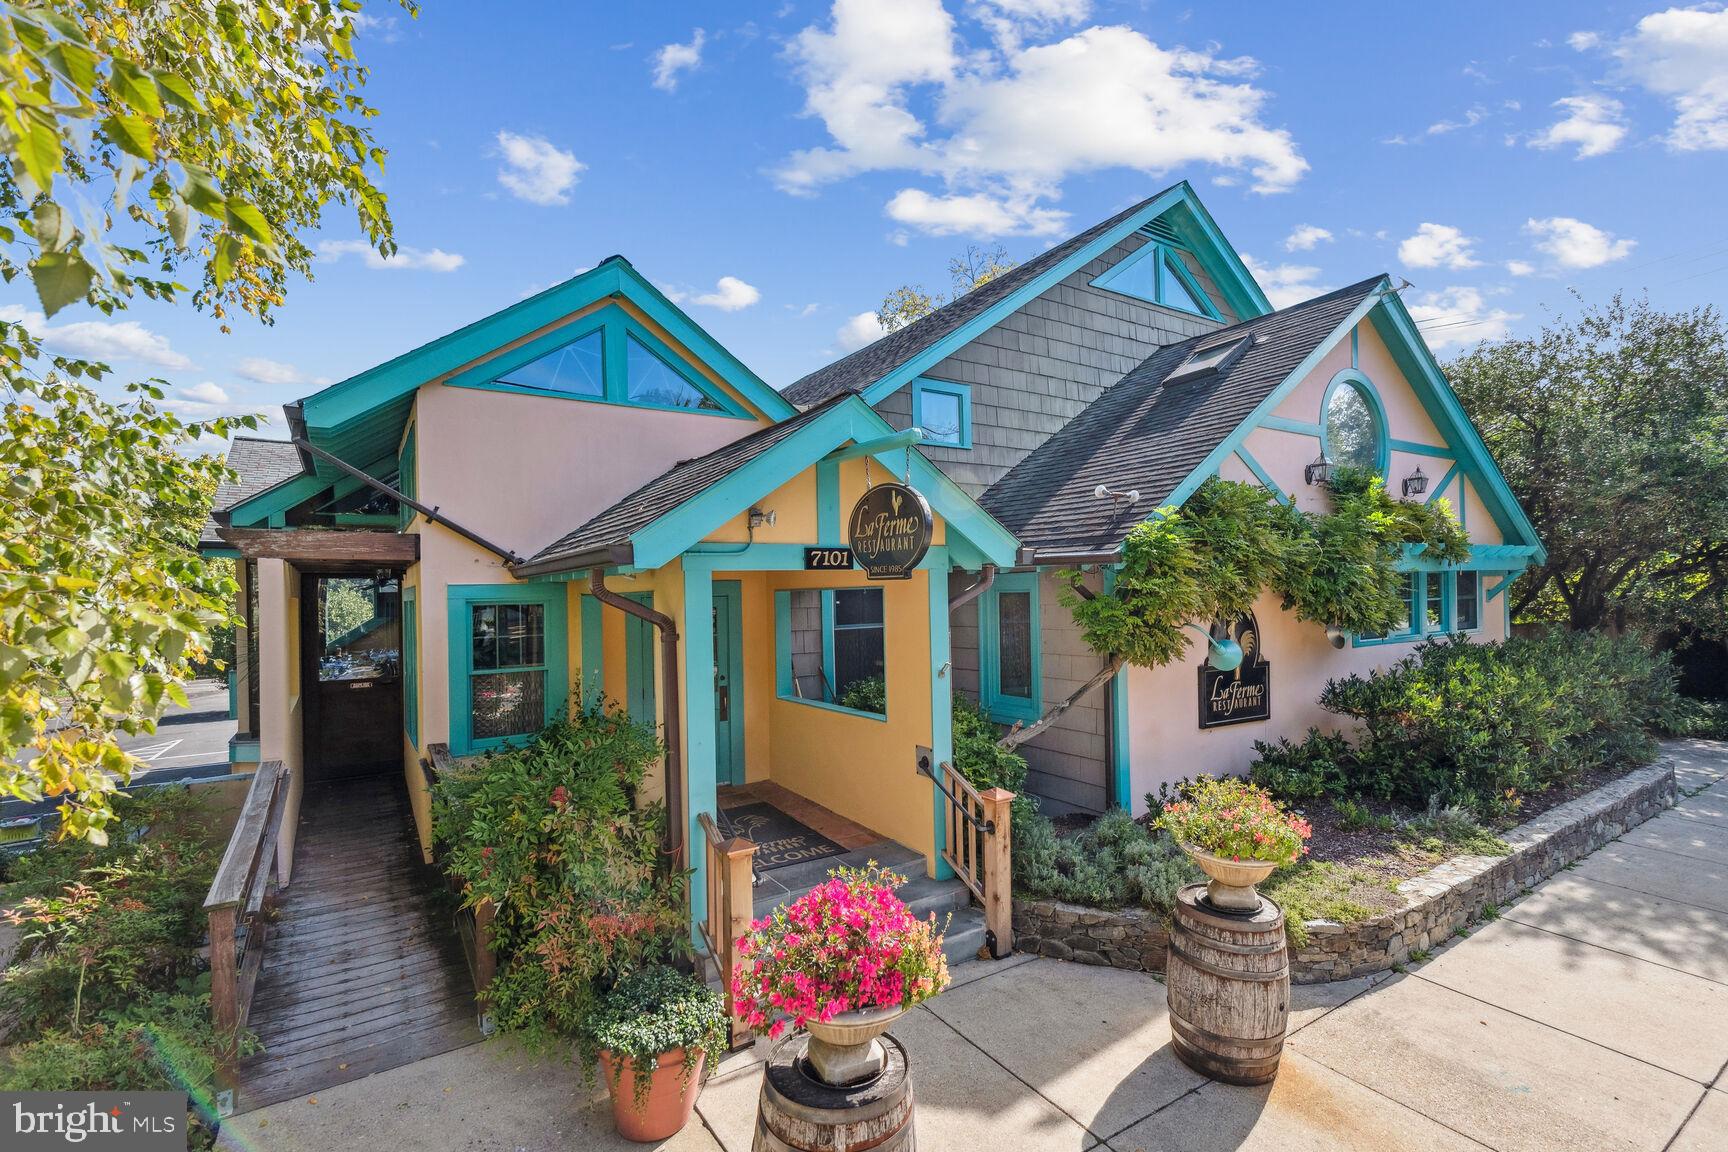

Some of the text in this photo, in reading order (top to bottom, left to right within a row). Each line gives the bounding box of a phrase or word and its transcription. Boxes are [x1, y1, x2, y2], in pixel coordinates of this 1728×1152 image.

[857, 536, 915, 553] RESTAURANT
[810, 551, 849, 567] 7101
[870, 564, 903, 574] SINCE 1985
[1212, 696, 1262, 712] RESTAURANT
